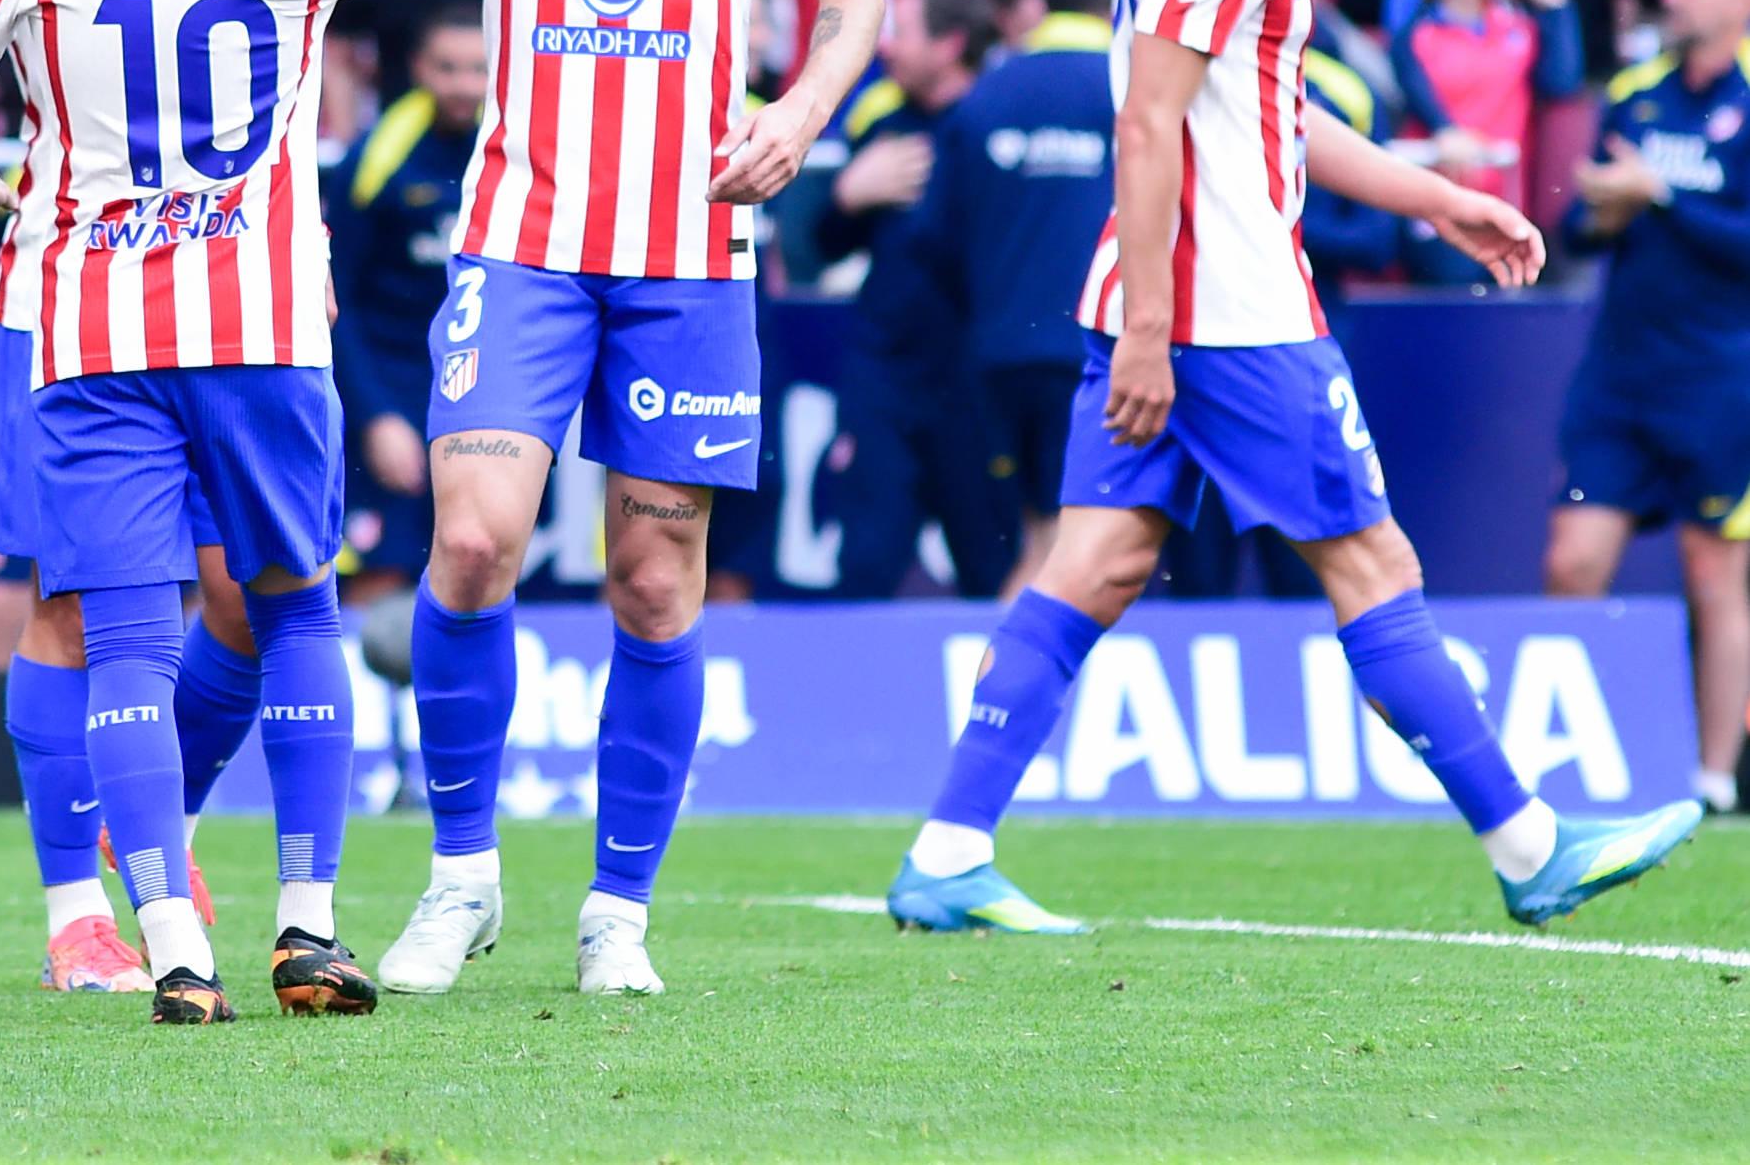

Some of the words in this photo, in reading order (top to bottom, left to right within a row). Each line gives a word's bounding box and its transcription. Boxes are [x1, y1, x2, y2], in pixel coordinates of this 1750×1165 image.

[537, 27, 636, 55] RIYADH
[642, 33, 687, 58] AIR
[84, 206, 250, 249] RWANDA
[448, 266, 487, 343] 3
[87, 705, 160, 732] ATLETI
[261, 704, 336, 721] ATLETI
